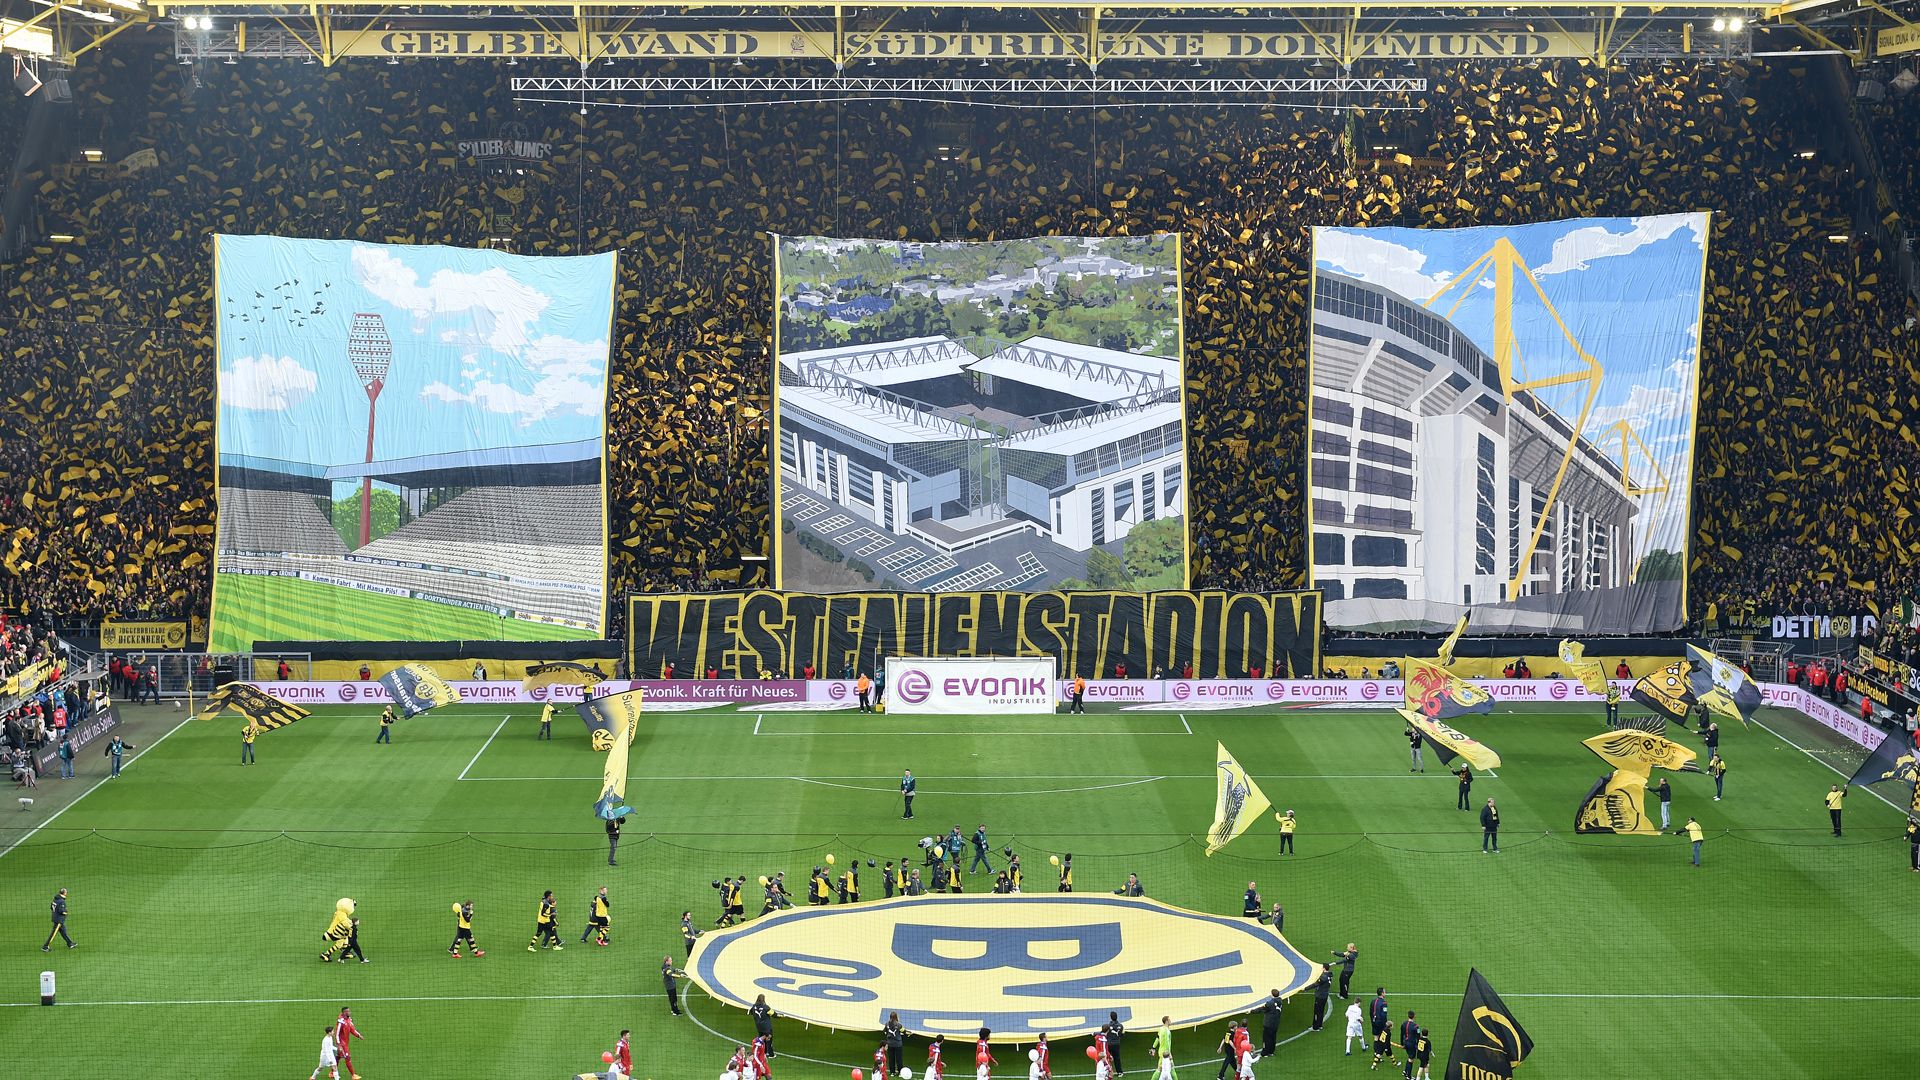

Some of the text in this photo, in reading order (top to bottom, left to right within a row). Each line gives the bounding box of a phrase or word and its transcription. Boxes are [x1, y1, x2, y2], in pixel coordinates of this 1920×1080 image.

[381, 33, 562, 54] GELBE
[597, 33, 758, 55] WAND
[1226, 34, 1550, 56] DORTMUND
[459, 686, 516, 697] EVONIK
[692, 685, 725, 698] Kraft
[729, 685, 748, 698] für
[752, 686, 798, 698] Neues.
[941, 677, 1046, 696] EVONIK
[1088, 686, 1144, 696] EVONIK
[1197, 685, 1253, 696] EVONIK
[1291, 685, 1348, 696] EVONIK
[753, 951, 882, 1002] 09
